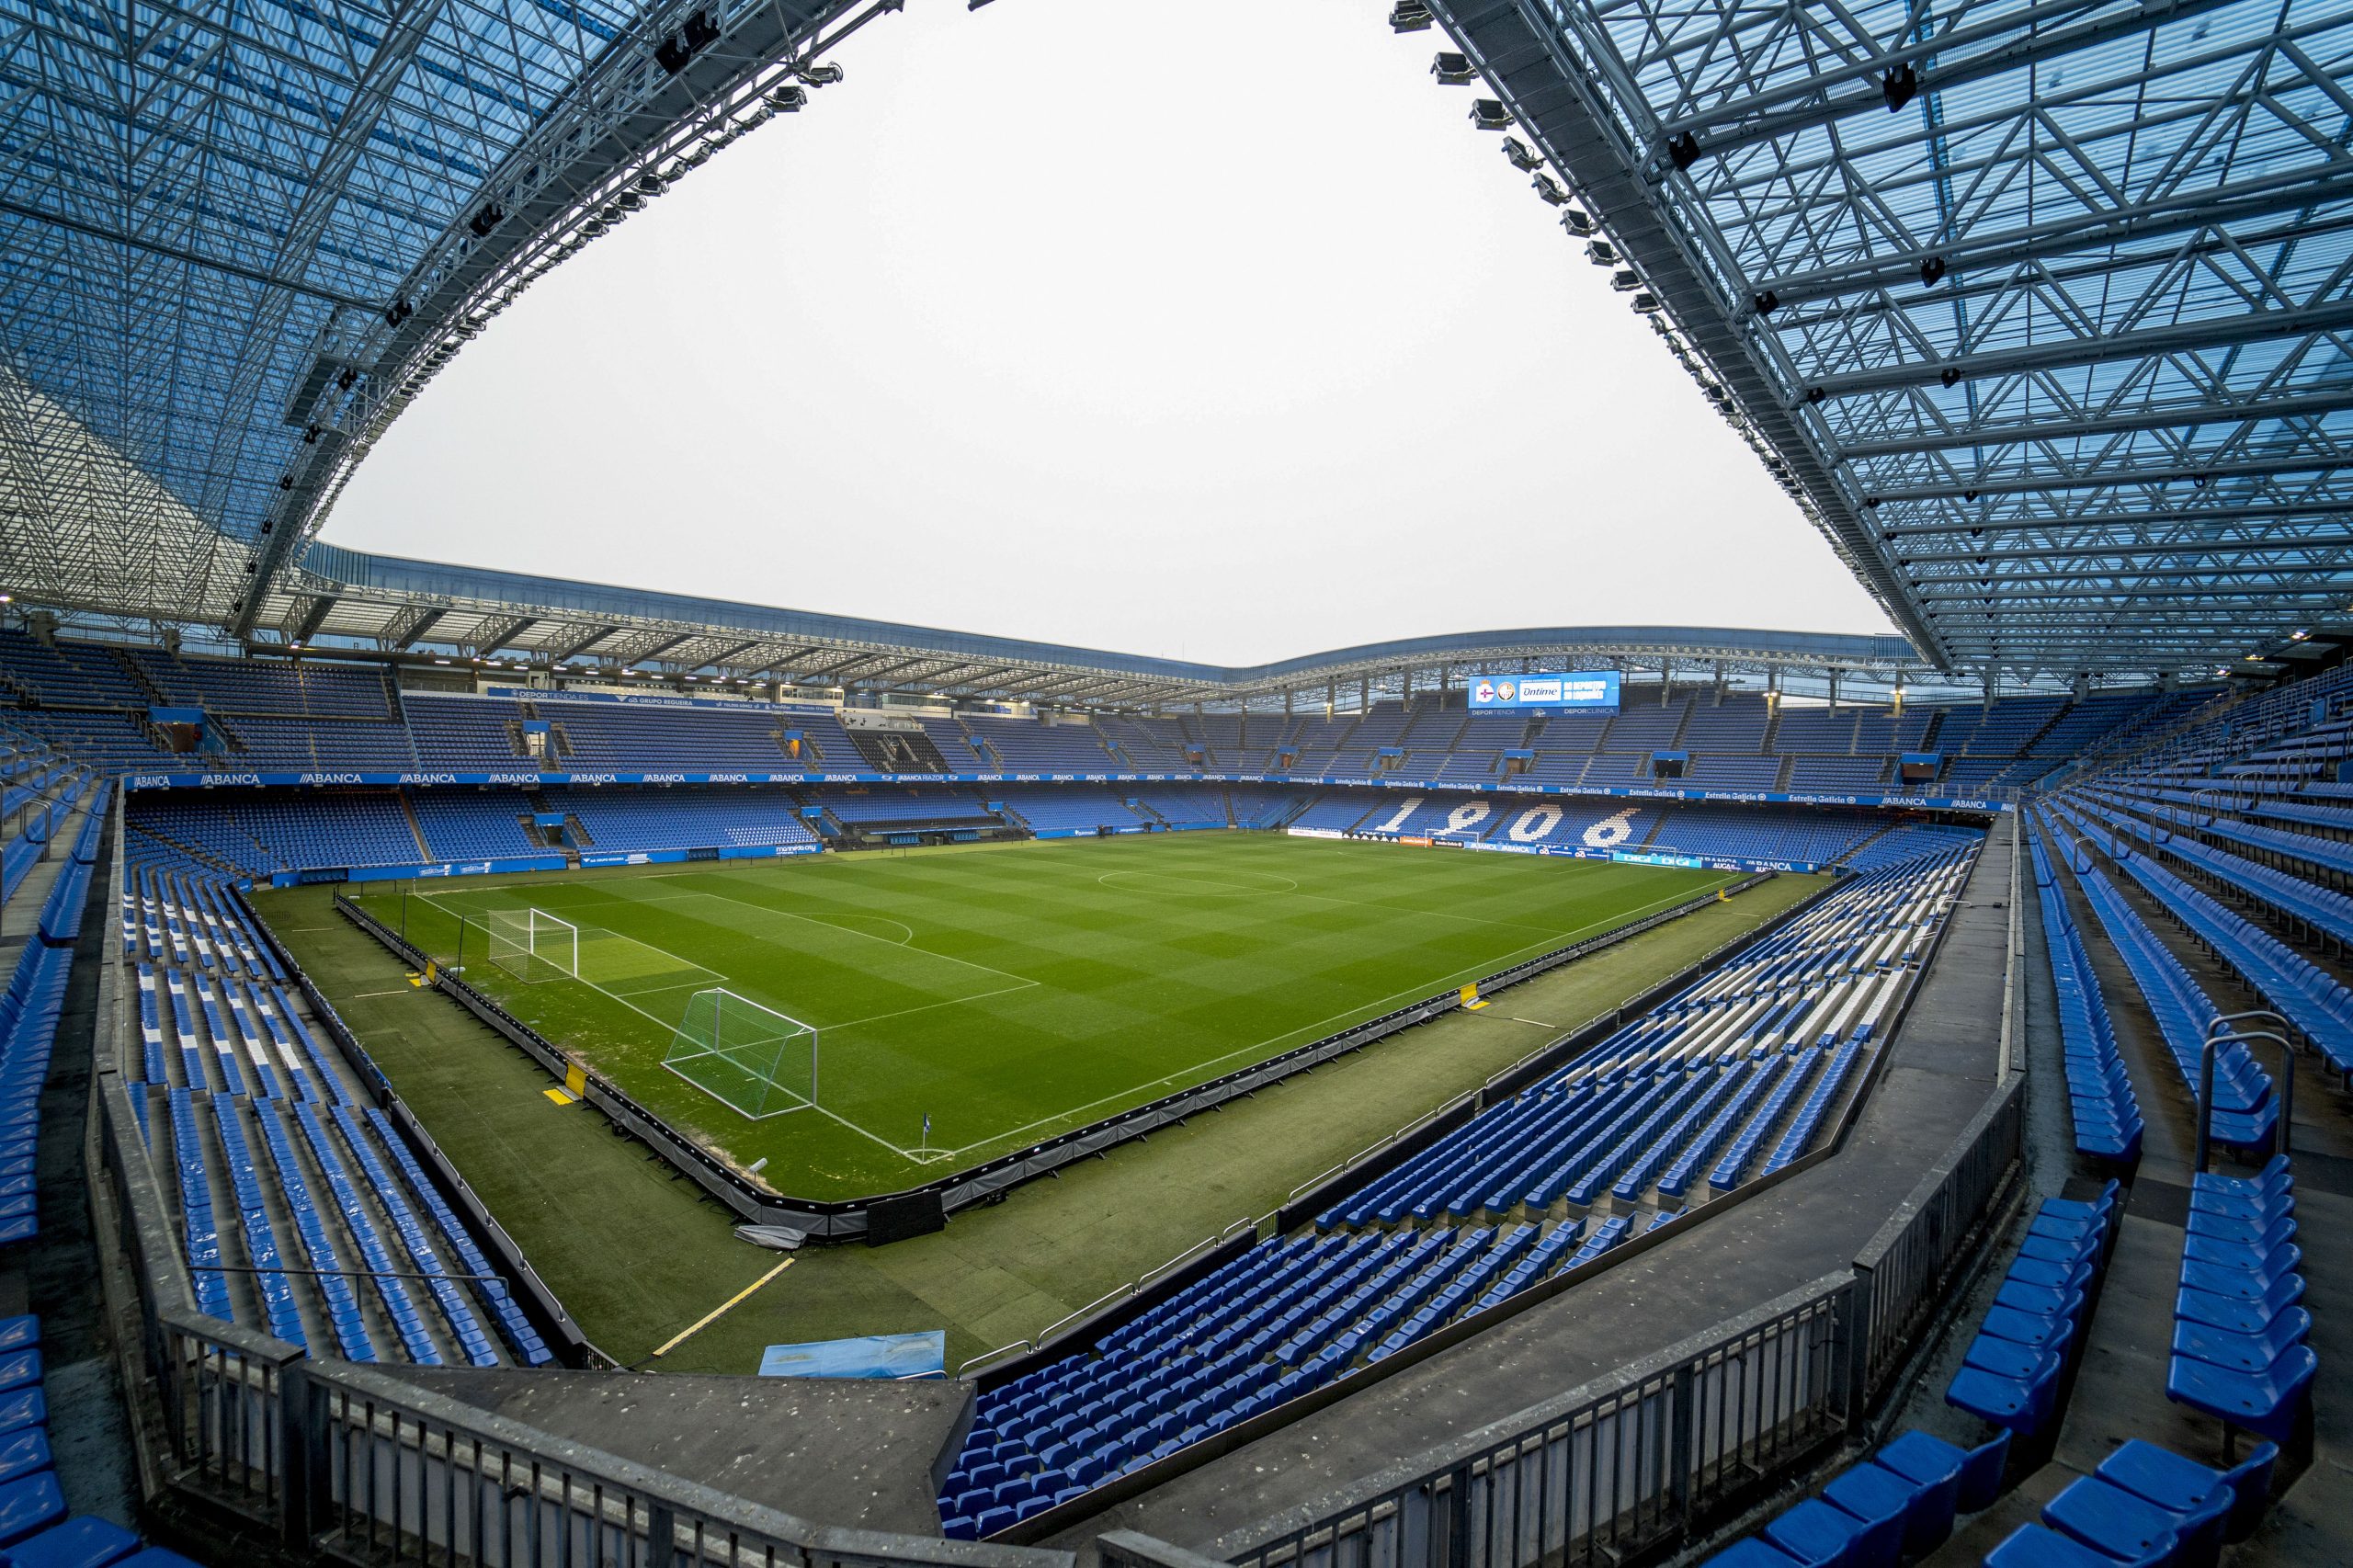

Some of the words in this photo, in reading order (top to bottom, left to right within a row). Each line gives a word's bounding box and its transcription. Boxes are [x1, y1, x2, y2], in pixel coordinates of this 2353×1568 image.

[137, 775, 170, 788] ABANCA
[206, 774, 260, 785] ABANCA
[306, 773, 362, 783] ABANCA
[404, 774, 456, 783] ABANCA
[493, 774, 540, 783] ABANCA
[574, 774, 617, 782] ABANCA
[647, 774, 686, 782] ABANCA
[712, 774, 747, 782] ABANCA
[772, 774, 804, 782] ABANCA
[827, 774, 858, 782] ABANCA
[1705, 791, 1731, 800] Estrella
[1732, 792, 1756, 801] Galicia
[1887, 797, 1927, 806] ABANCA
[1954, 800, 1987, 810] ABANCA
[1376, 798, 1641, 846] 1906
[1624, 855, 1652, 864] DIGI
